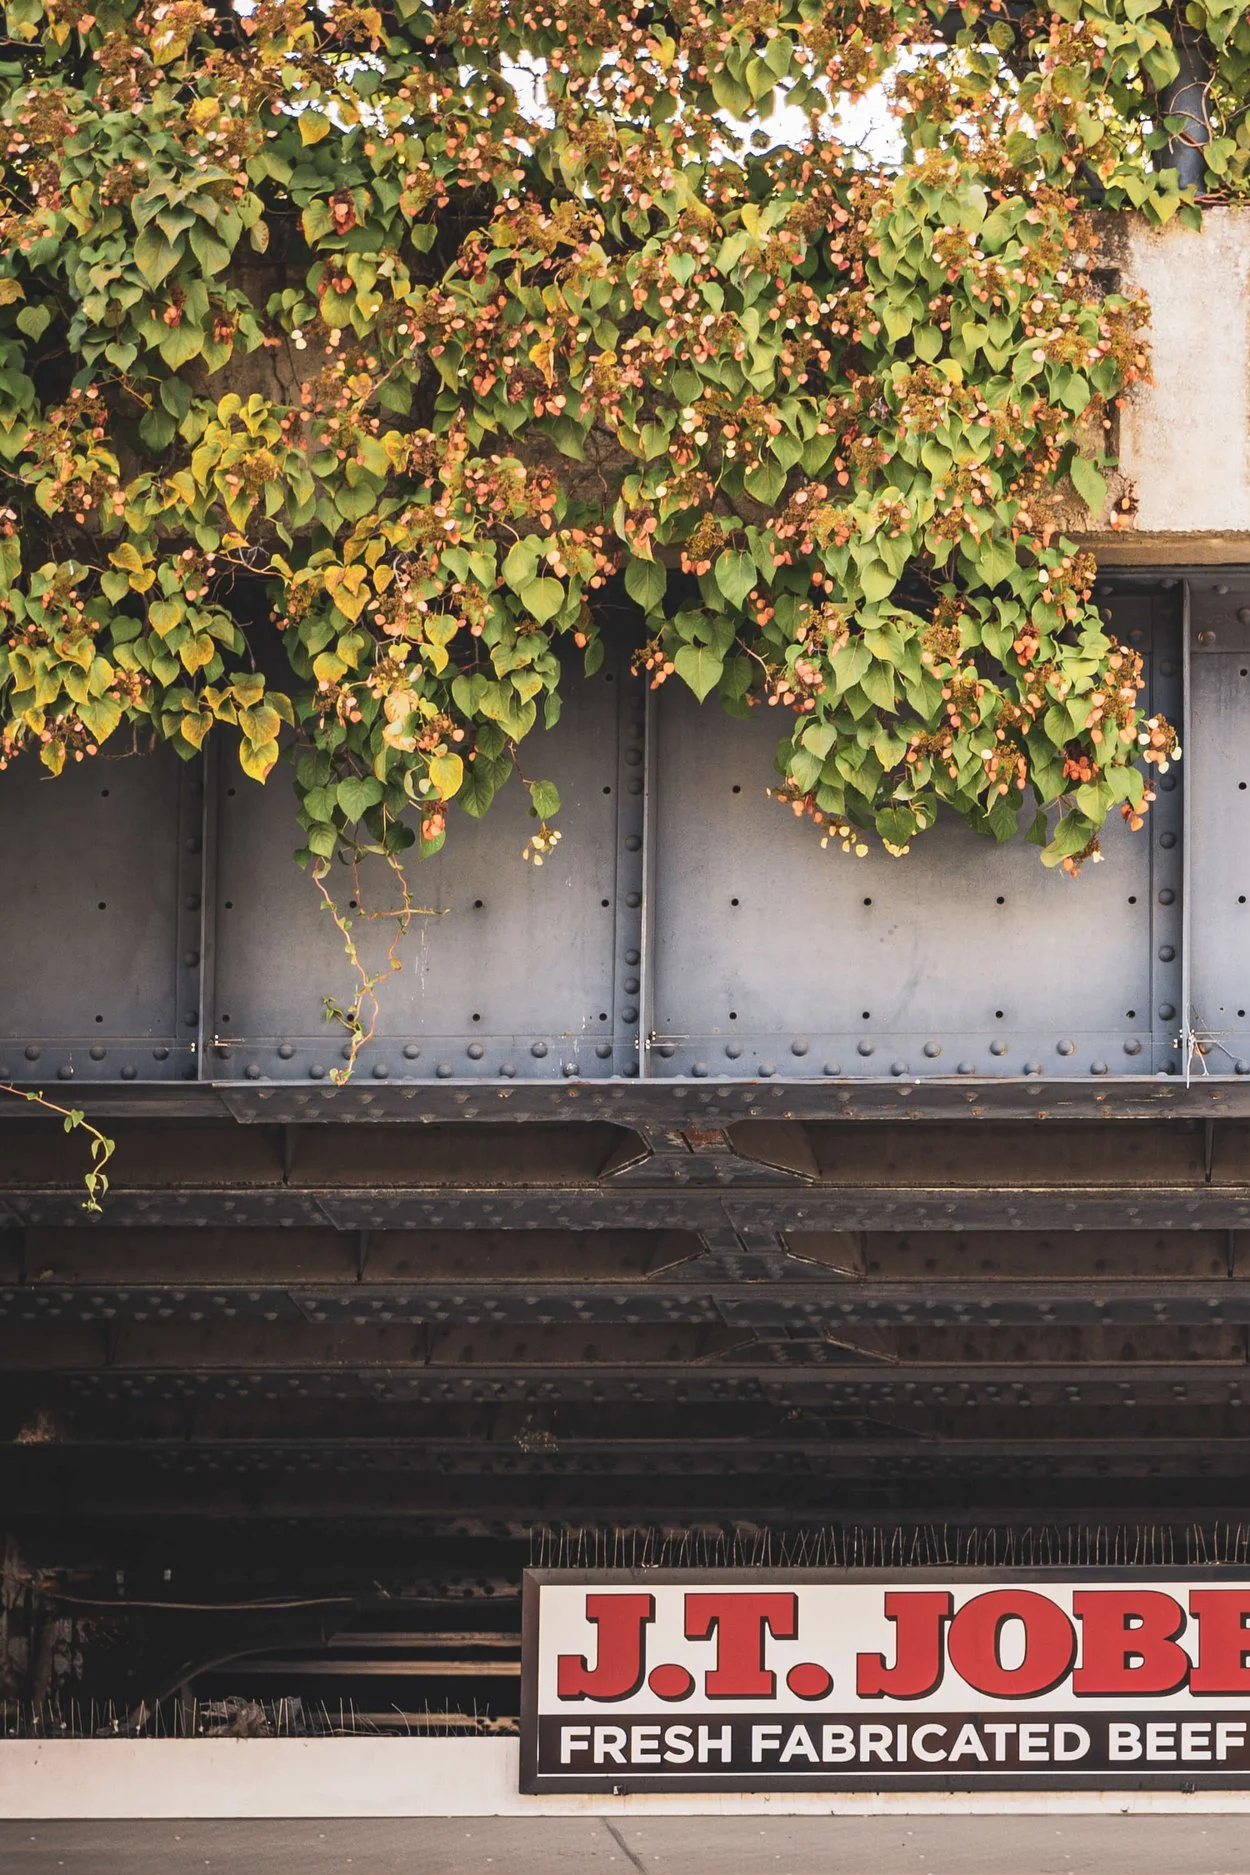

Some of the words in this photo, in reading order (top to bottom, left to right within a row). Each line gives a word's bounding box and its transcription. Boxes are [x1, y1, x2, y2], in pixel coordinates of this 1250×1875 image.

[557, 1591, 834, 1702] J.T.
[559, 1725, 732, 1764] FRESH
[751, 1722, 1091, 1763] FABRICATED
[1108, 1722, 1247, 1761] BEEF
